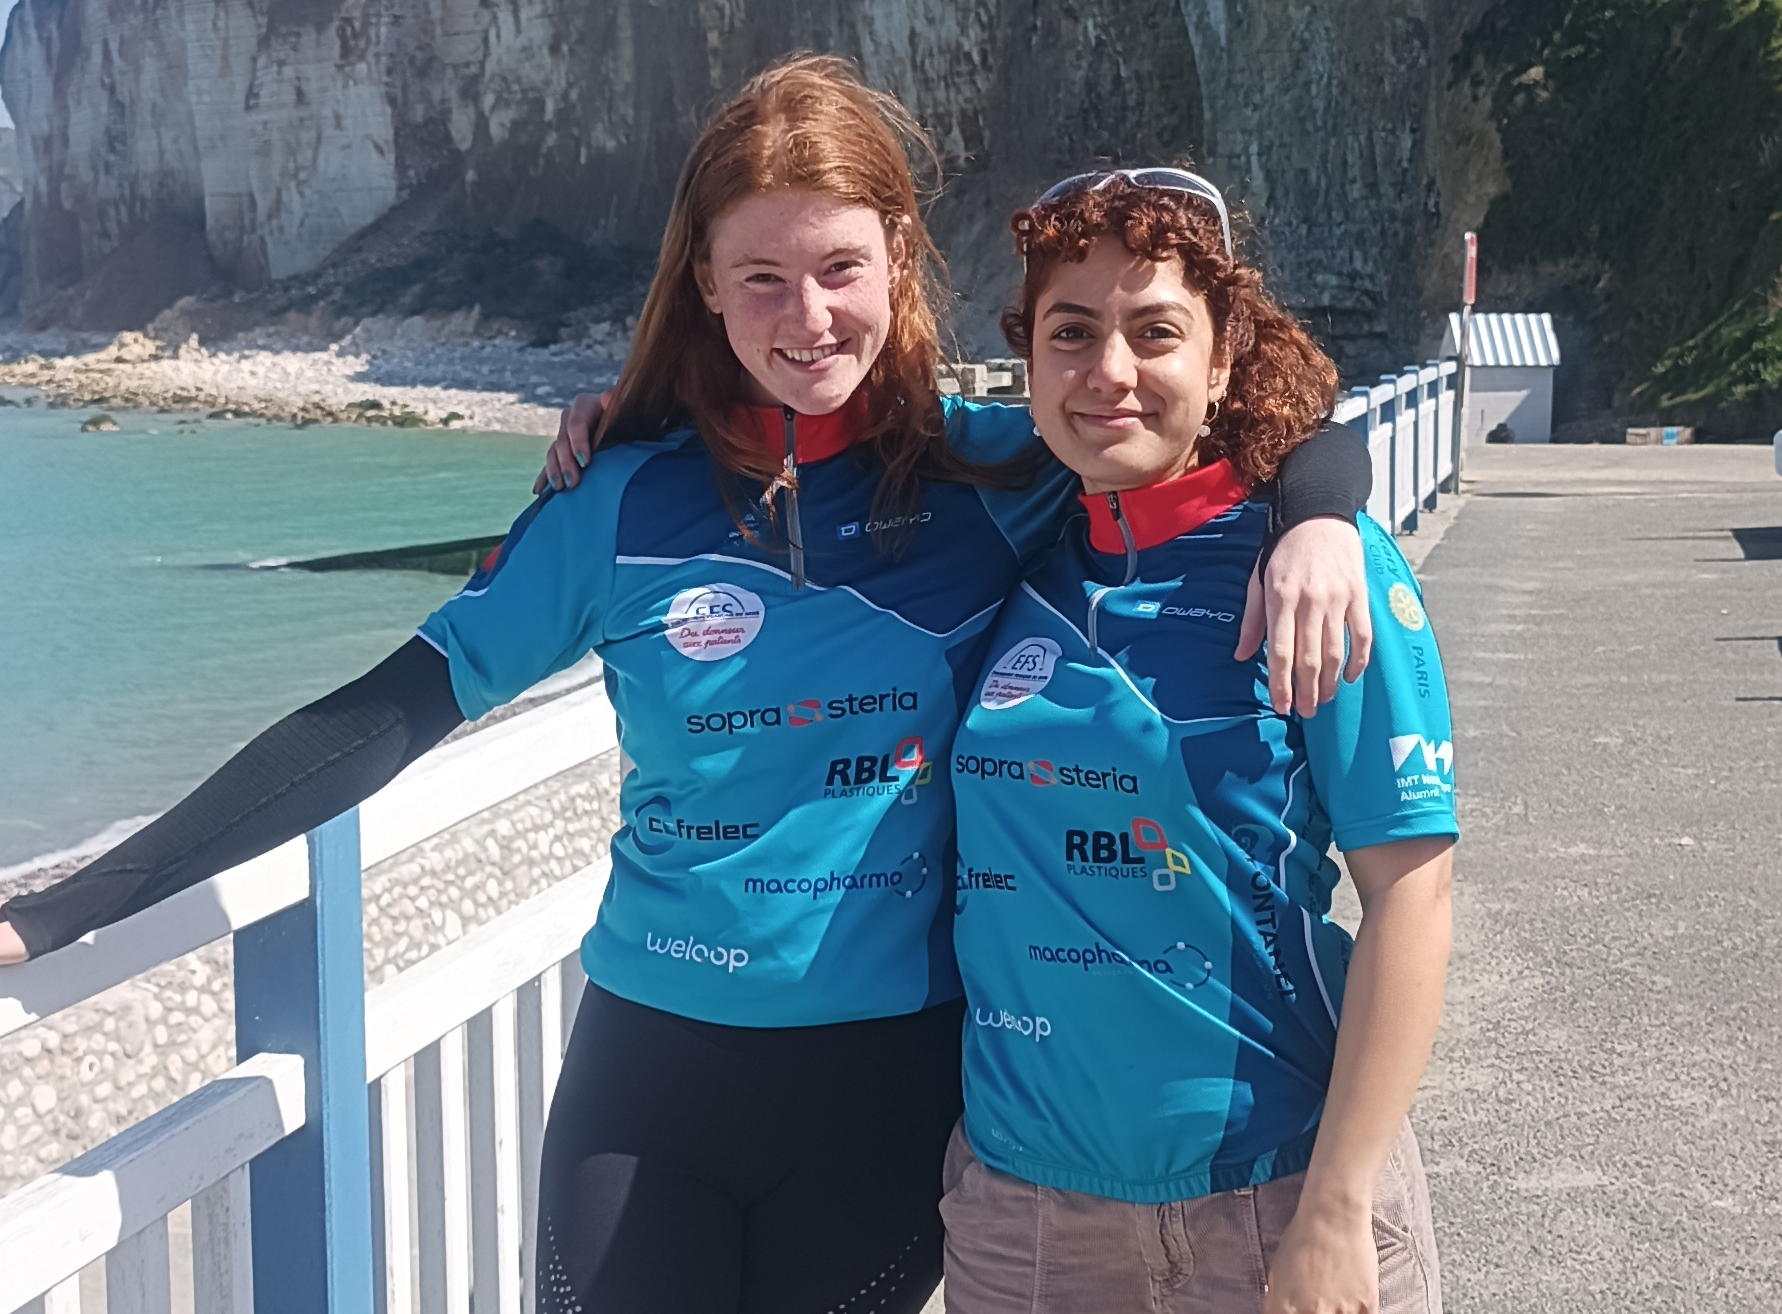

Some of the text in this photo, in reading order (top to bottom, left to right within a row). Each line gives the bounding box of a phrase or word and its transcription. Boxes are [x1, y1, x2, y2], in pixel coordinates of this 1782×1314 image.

[1011, 654, 1040, 672] EFS
[1411, 645, 1431, 700] PARIS
[686, 687, 918, 735] sopra steria
[825, 753, 900, 787] RBL
[955, 755, 1139, 795] sopra steria
[823, 784, 902, 799] PLASTIQUES
[1065, 829, 1146, 866] RBL
[744, 870, 903, 901] macopharma
[1066, 863, 1148, 880] PLASTIQUES
[646, 932, 750, 973] weloop
[1028, 942, 1174, 974] macophama
[975, 1008, 1052, 1043] weop
